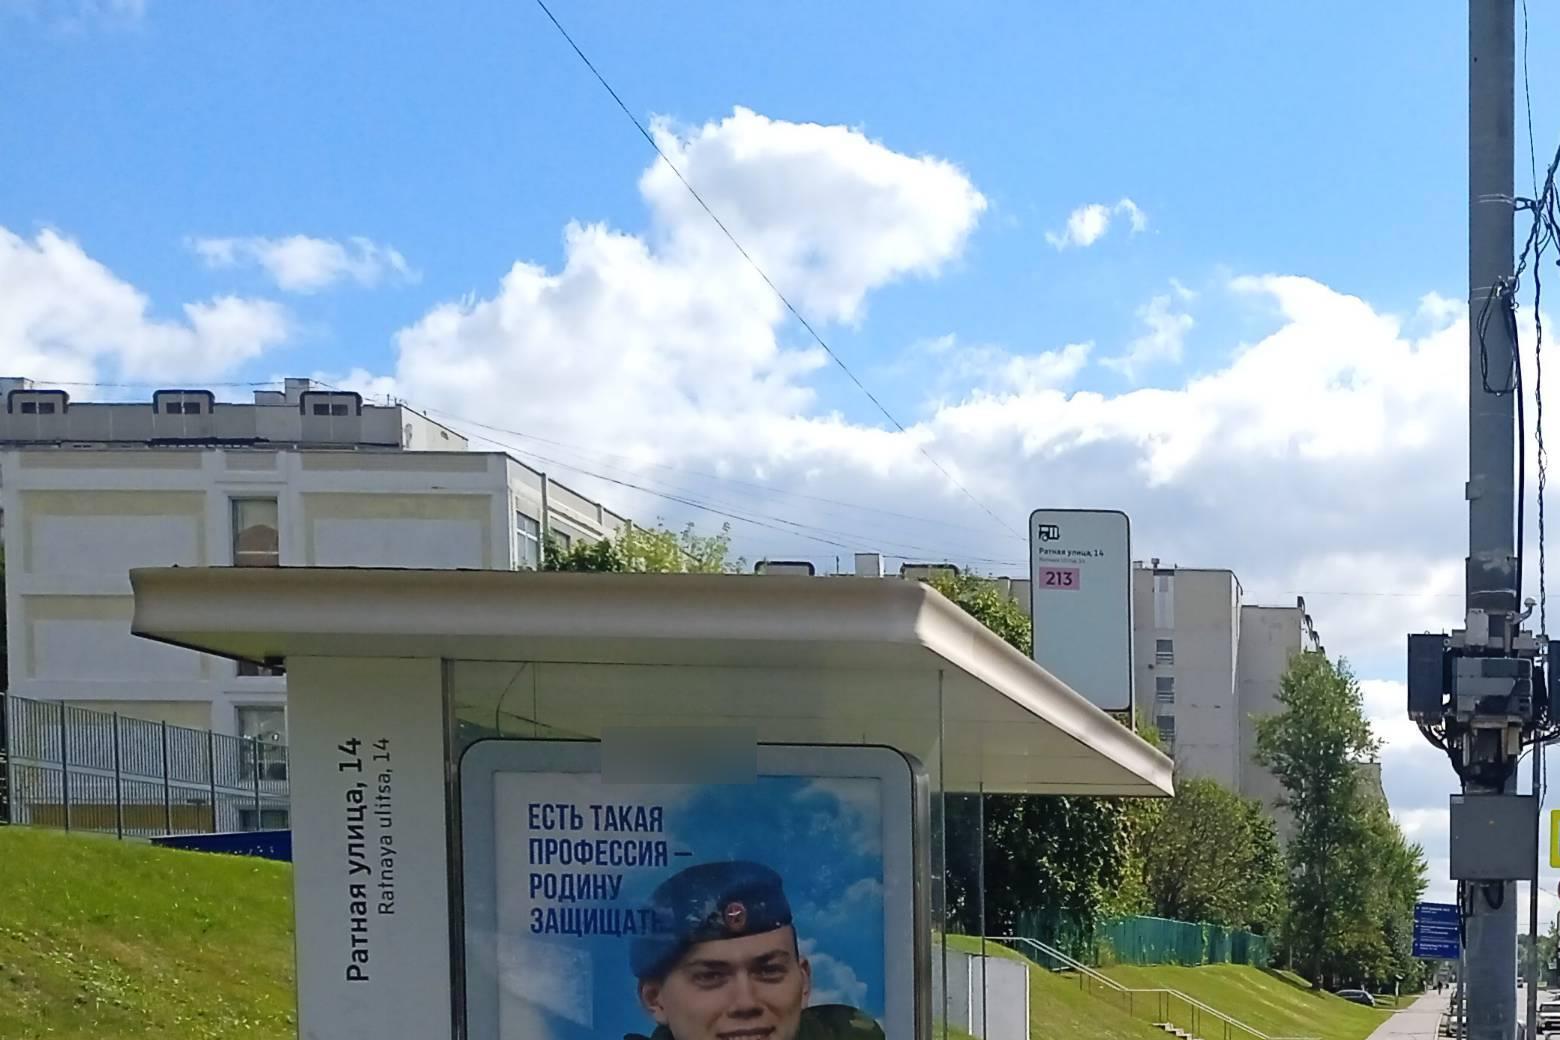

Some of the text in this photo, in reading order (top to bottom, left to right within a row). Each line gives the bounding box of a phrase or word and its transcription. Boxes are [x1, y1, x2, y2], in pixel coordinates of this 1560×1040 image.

[1094, 549, 1104, 557] 14
[1046, 571, 1072, 586] 213
[372, 737, 397, 914] Ratnaya ulitsa, 14
[528, 803, 663, 832] ЕСТЬ ТАКАЯ
[338, 737, 371, 981] Ратная улица, 14
[529, 838, 667, 867] ПРОФЕССИЯ
[529, 873, 623, 902] РОДИНУ
